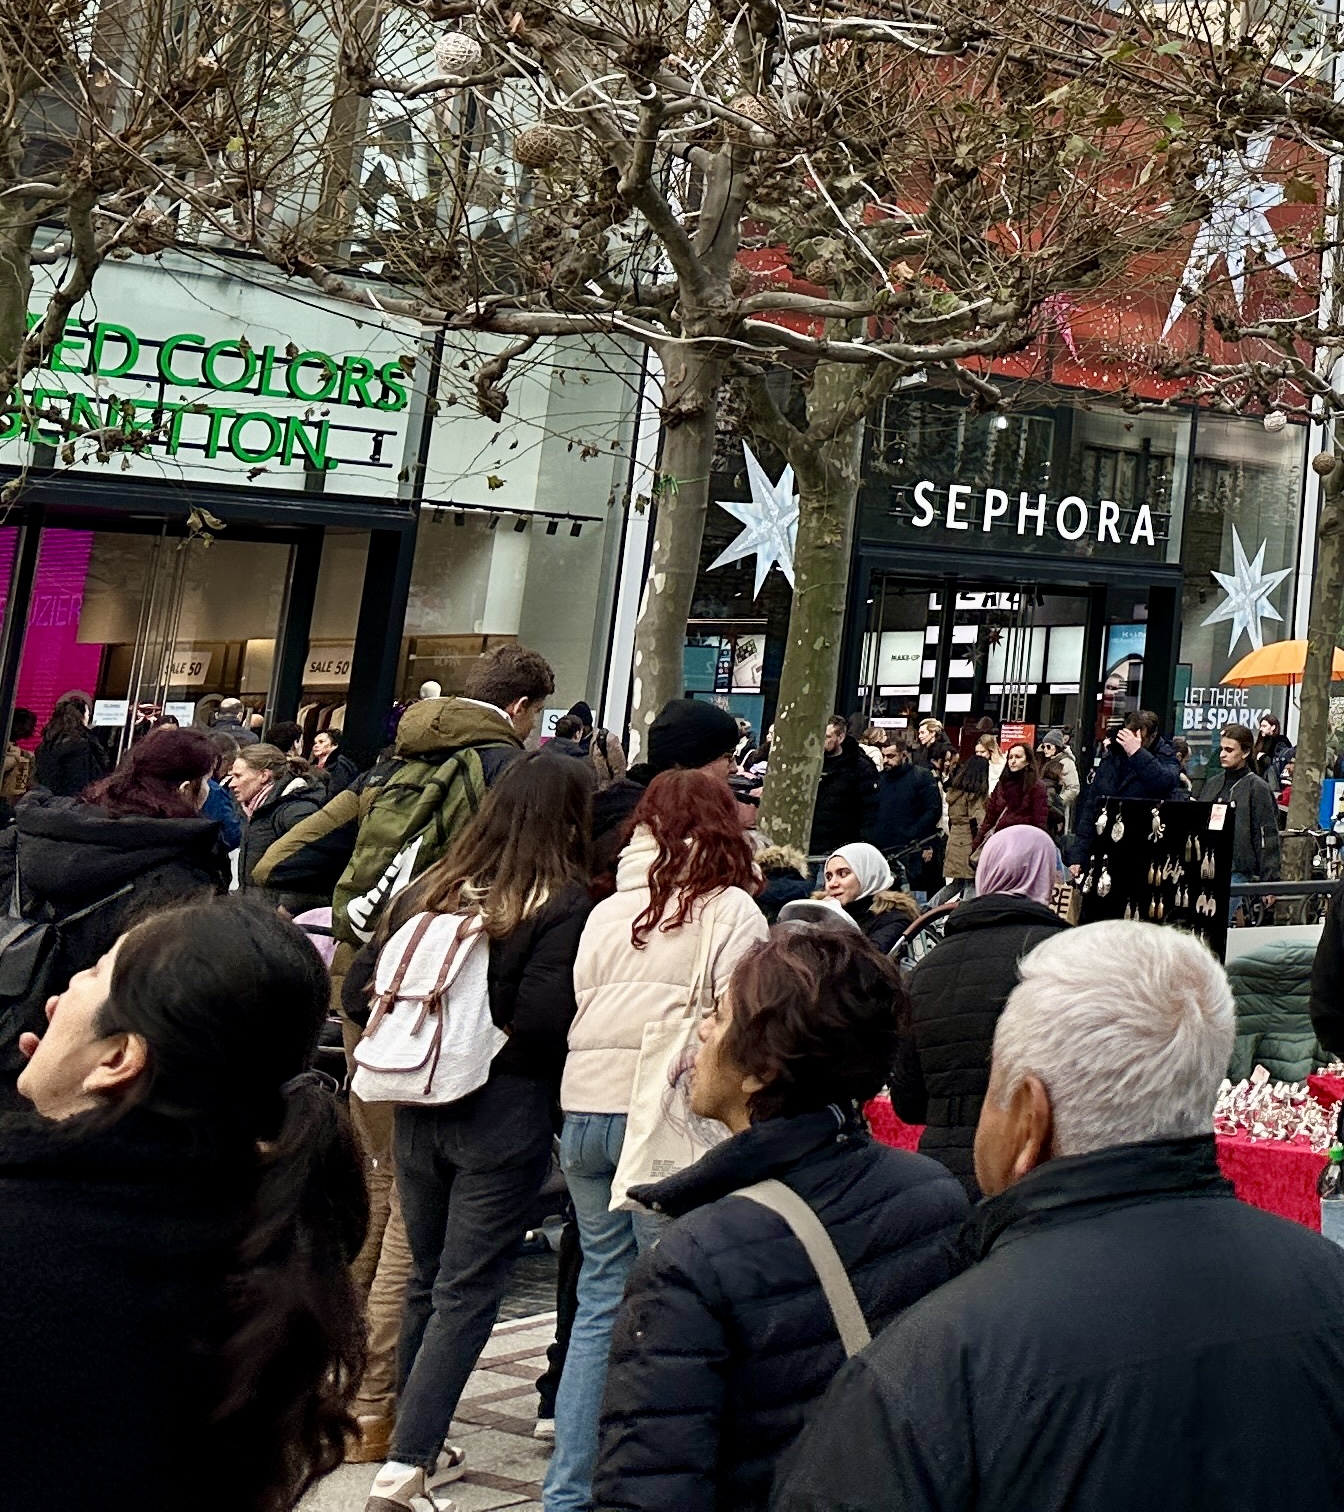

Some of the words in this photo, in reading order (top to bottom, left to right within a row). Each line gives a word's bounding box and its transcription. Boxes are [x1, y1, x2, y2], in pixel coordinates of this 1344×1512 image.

[26, 311, 139, 377] ED
[157, 333, 408, 412] COLORS
[911, 480, 1155, 546] SEPHORA
[309, 660, 332, 673] SALE
[1184, 687, 1206, 707] LET
[1209, 687, 1250, 707] THERE
[1183, 708, 1203, 730] BE
[1206, 708, 1272, 731] SPARK
